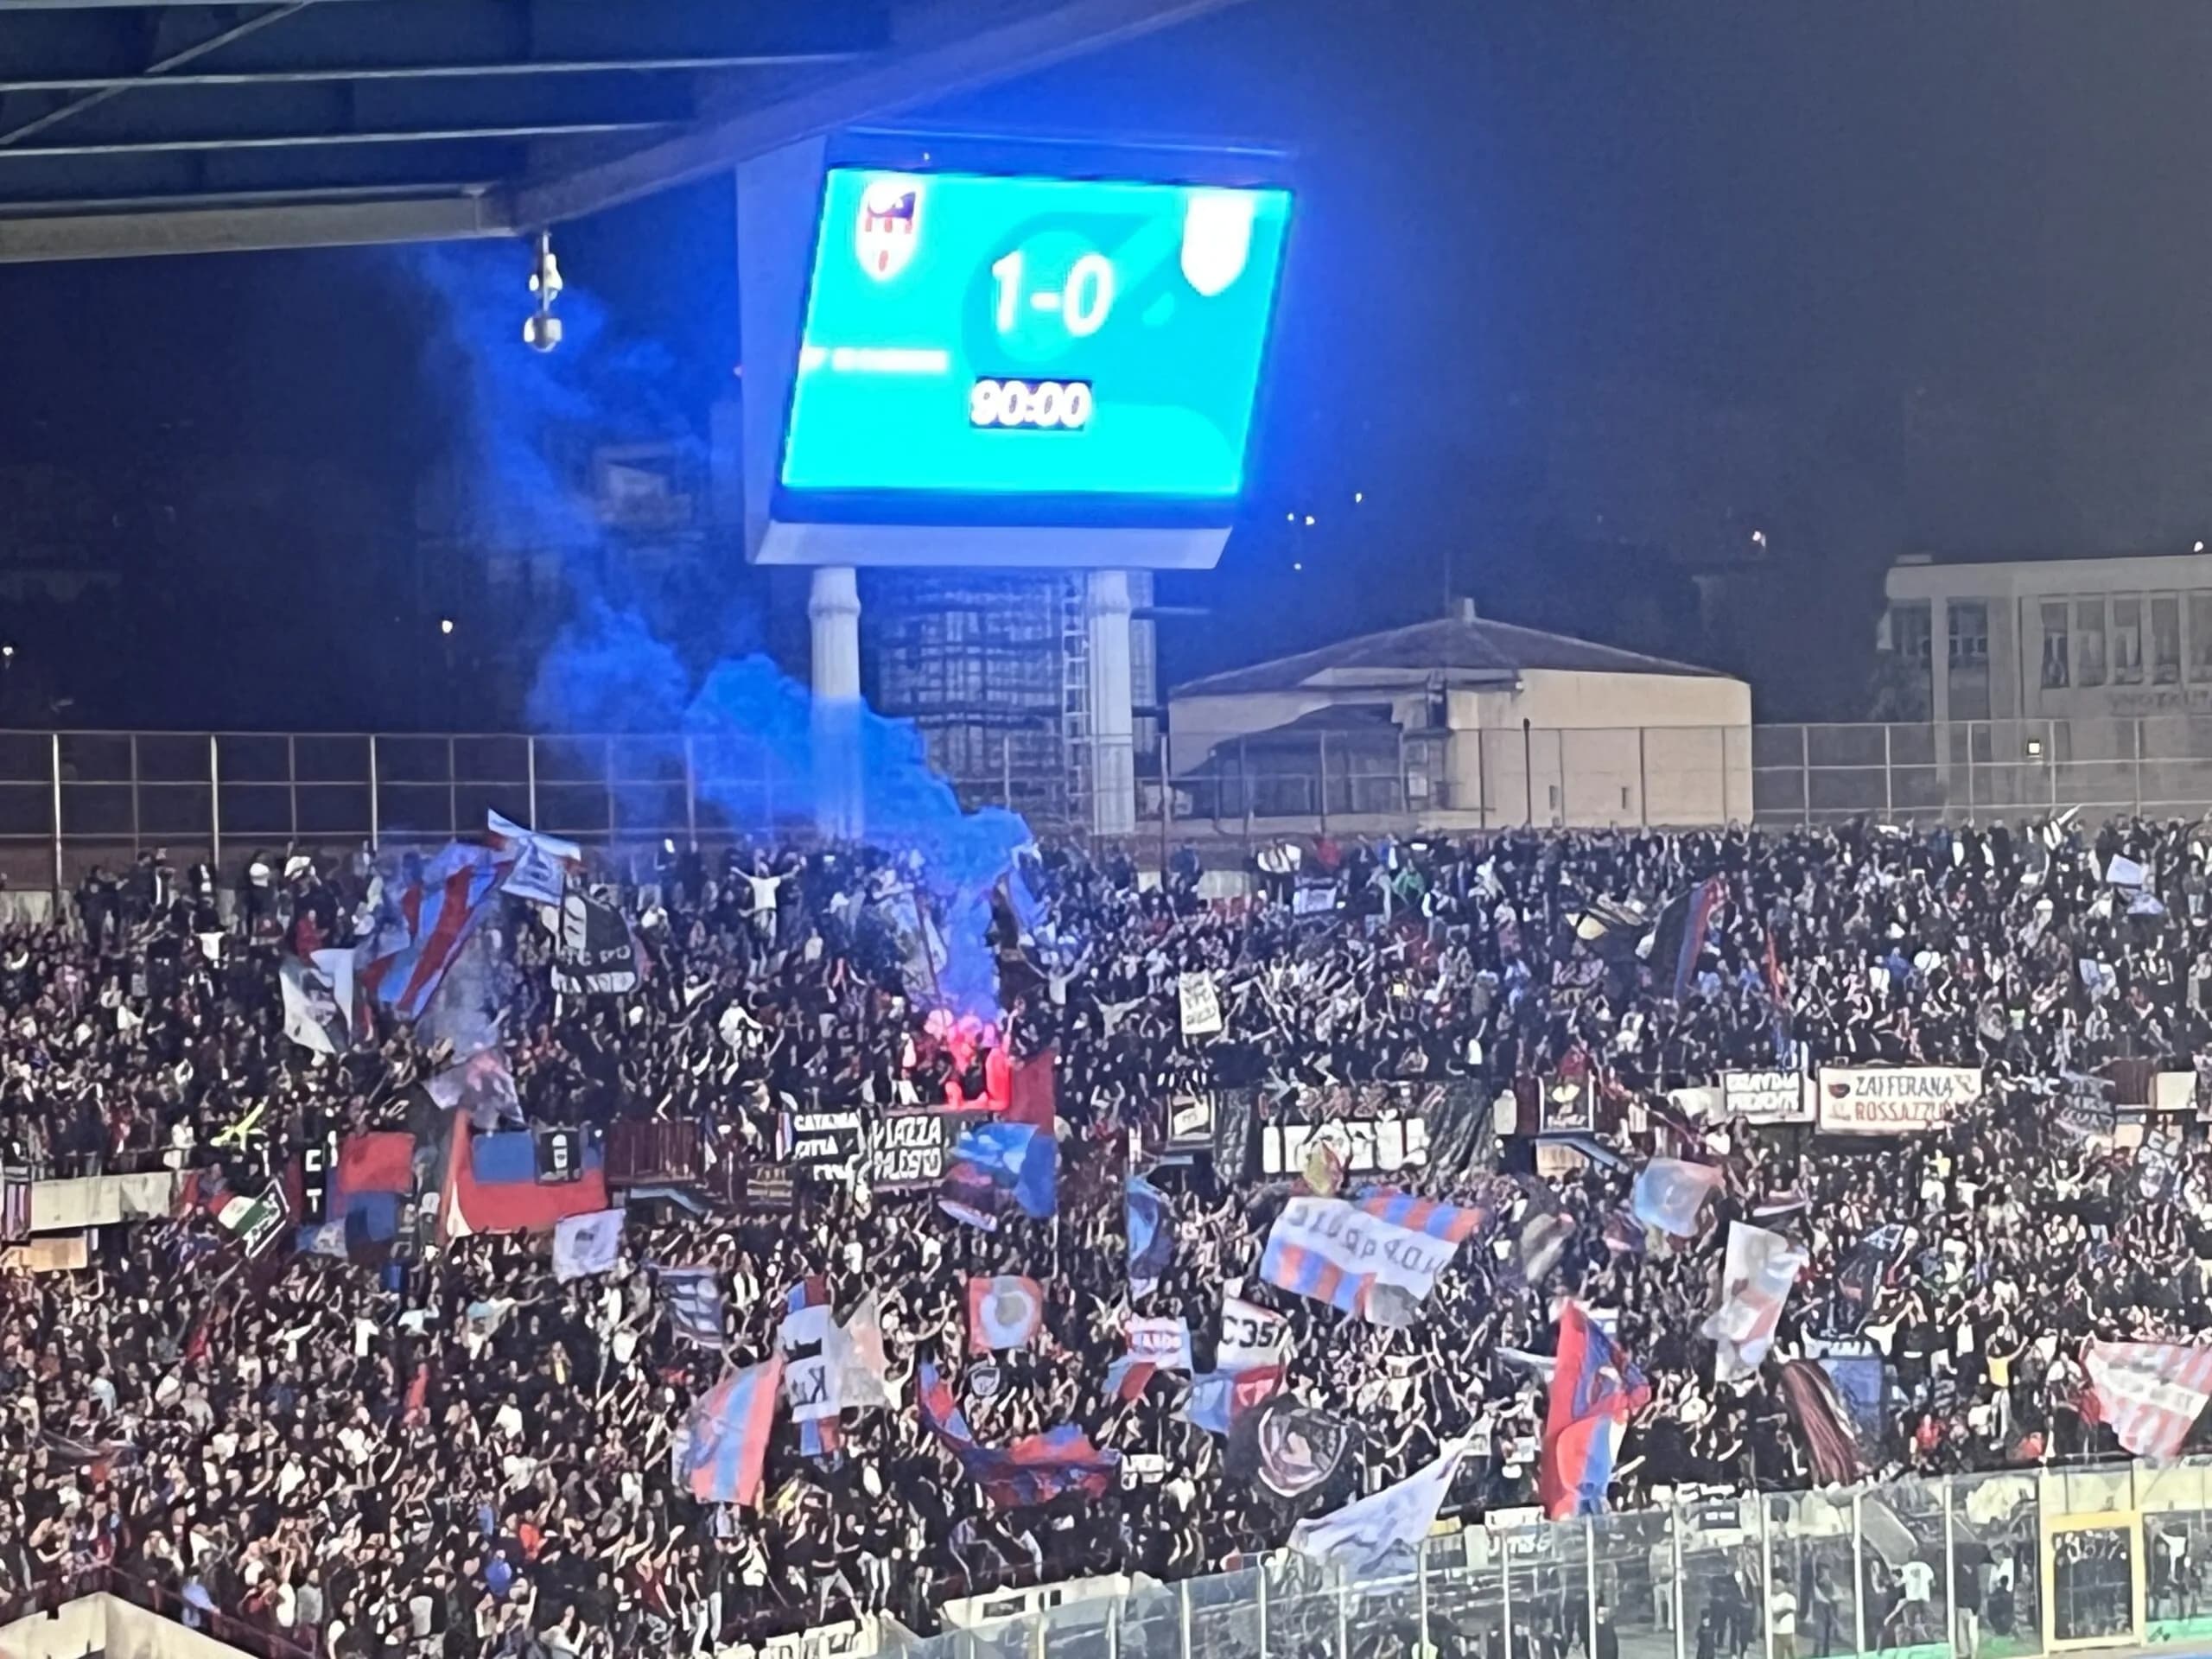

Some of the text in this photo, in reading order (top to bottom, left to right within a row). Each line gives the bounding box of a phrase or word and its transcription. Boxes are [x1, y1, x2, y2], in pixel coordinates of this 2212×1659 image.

[992, 249, 1114, 336] 1-0
[970, 379, 1092, 428] 90:00
[1854, 1075, 1955, 1098] ZAFFERANA
[872, 1116, 941, 1149] PIAZZA
